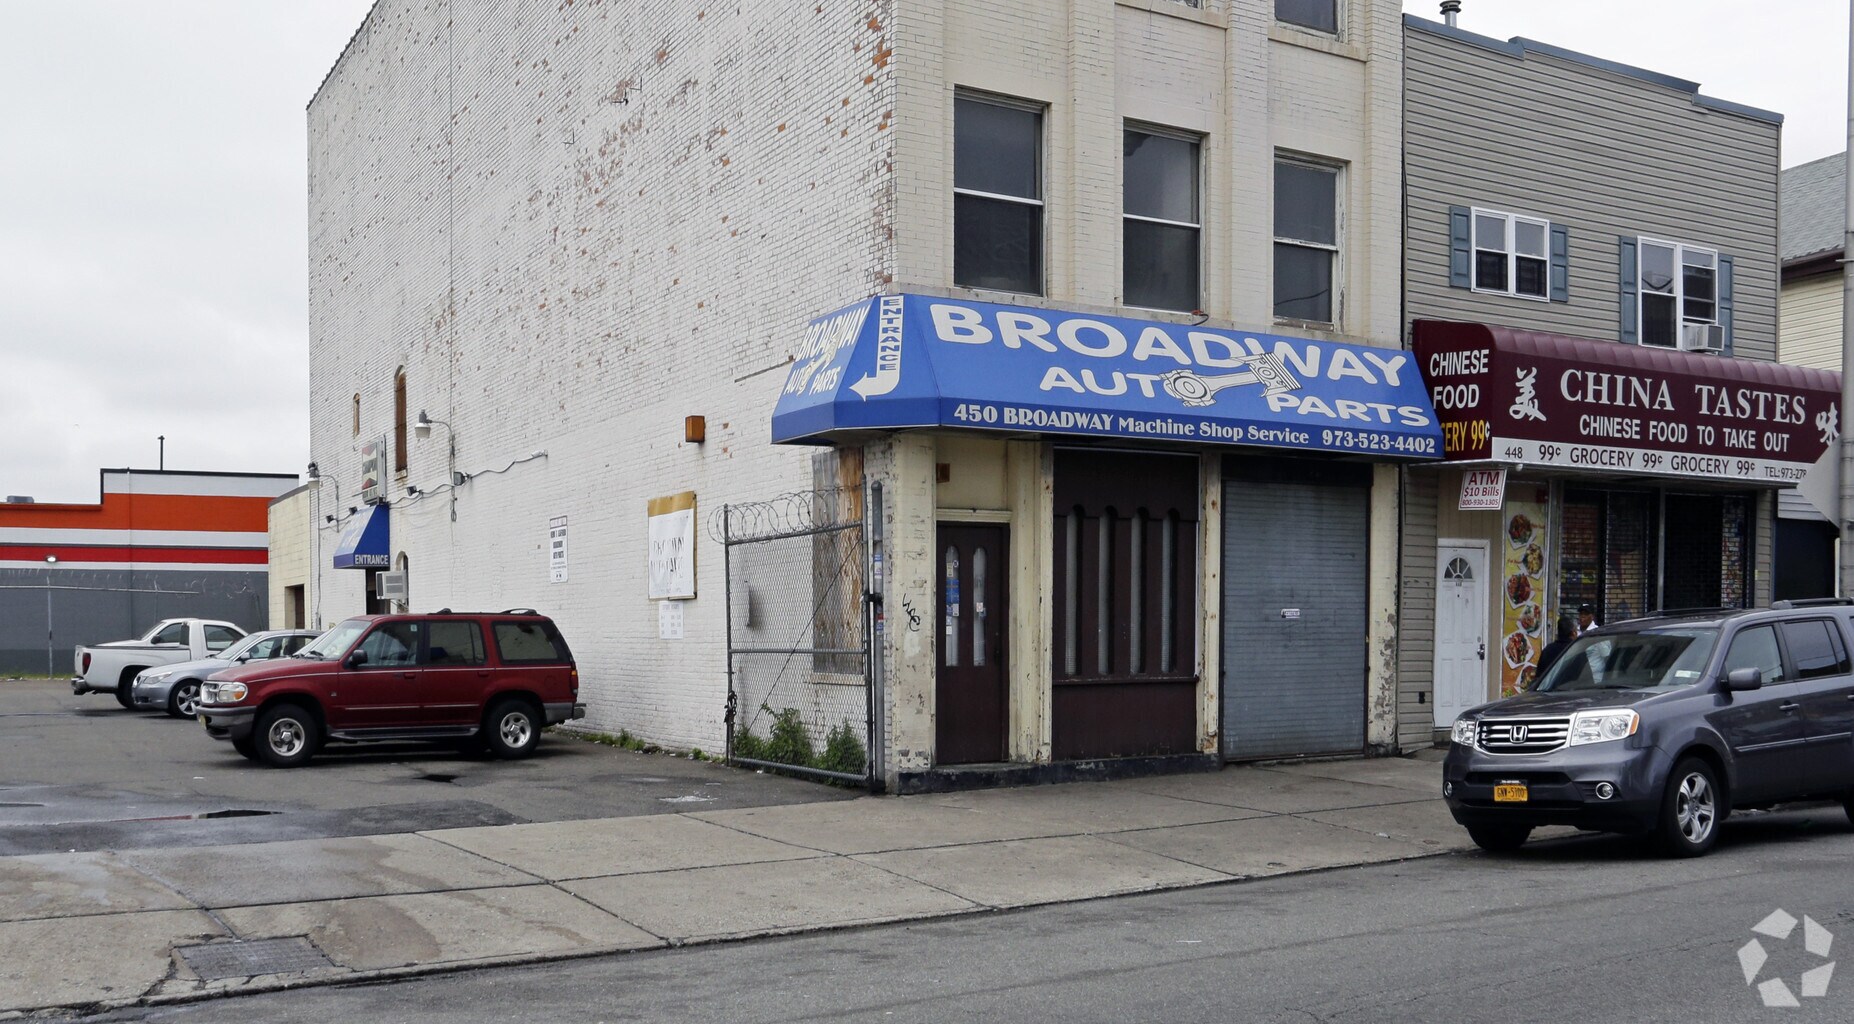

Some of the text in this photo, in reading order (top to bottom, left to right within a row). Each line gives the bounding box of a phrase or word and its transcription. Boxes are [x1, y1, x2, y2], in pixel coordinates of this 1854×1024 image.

[795, 304, 871, 362] BROADWAY
[880, 298, 902, 371] ENTRANCE
[930, 303, 1406, 387] BROADWAY
[1430, 349, 1489, 377] CHINESE
[809, 366, 841, 396] PARTS
[1433, 384, 1480, 409] FOOD
[1509, 366, 1547, 422] 美
[1560, 369, 1806, 425] CHINA TASTES
[1268, 393, 1431, 427] PARTS
[954, 404, 1436, 453] 450 BROADWAY Machine Shop Service 973-523-4402
[1579, 414, 1790, 453] CHINESE FOOD TO TAKE OUT
[1504, 446, 1523, 459] 448
[1539, 444, 1562, 461] 99¢
[1570, 447, 1635, 467] GROCERY
[1642, 452, 1663, 469] 99¢
[1671, 455, 1730, 475] GROCERY
[1736, 460, 1756, 476] 99¢
[1464, 486, 1499, 498] $10 Bills
[1468, 471, 1500, 486] ATM
[354, 554, 389, 565] ENTRANCE
